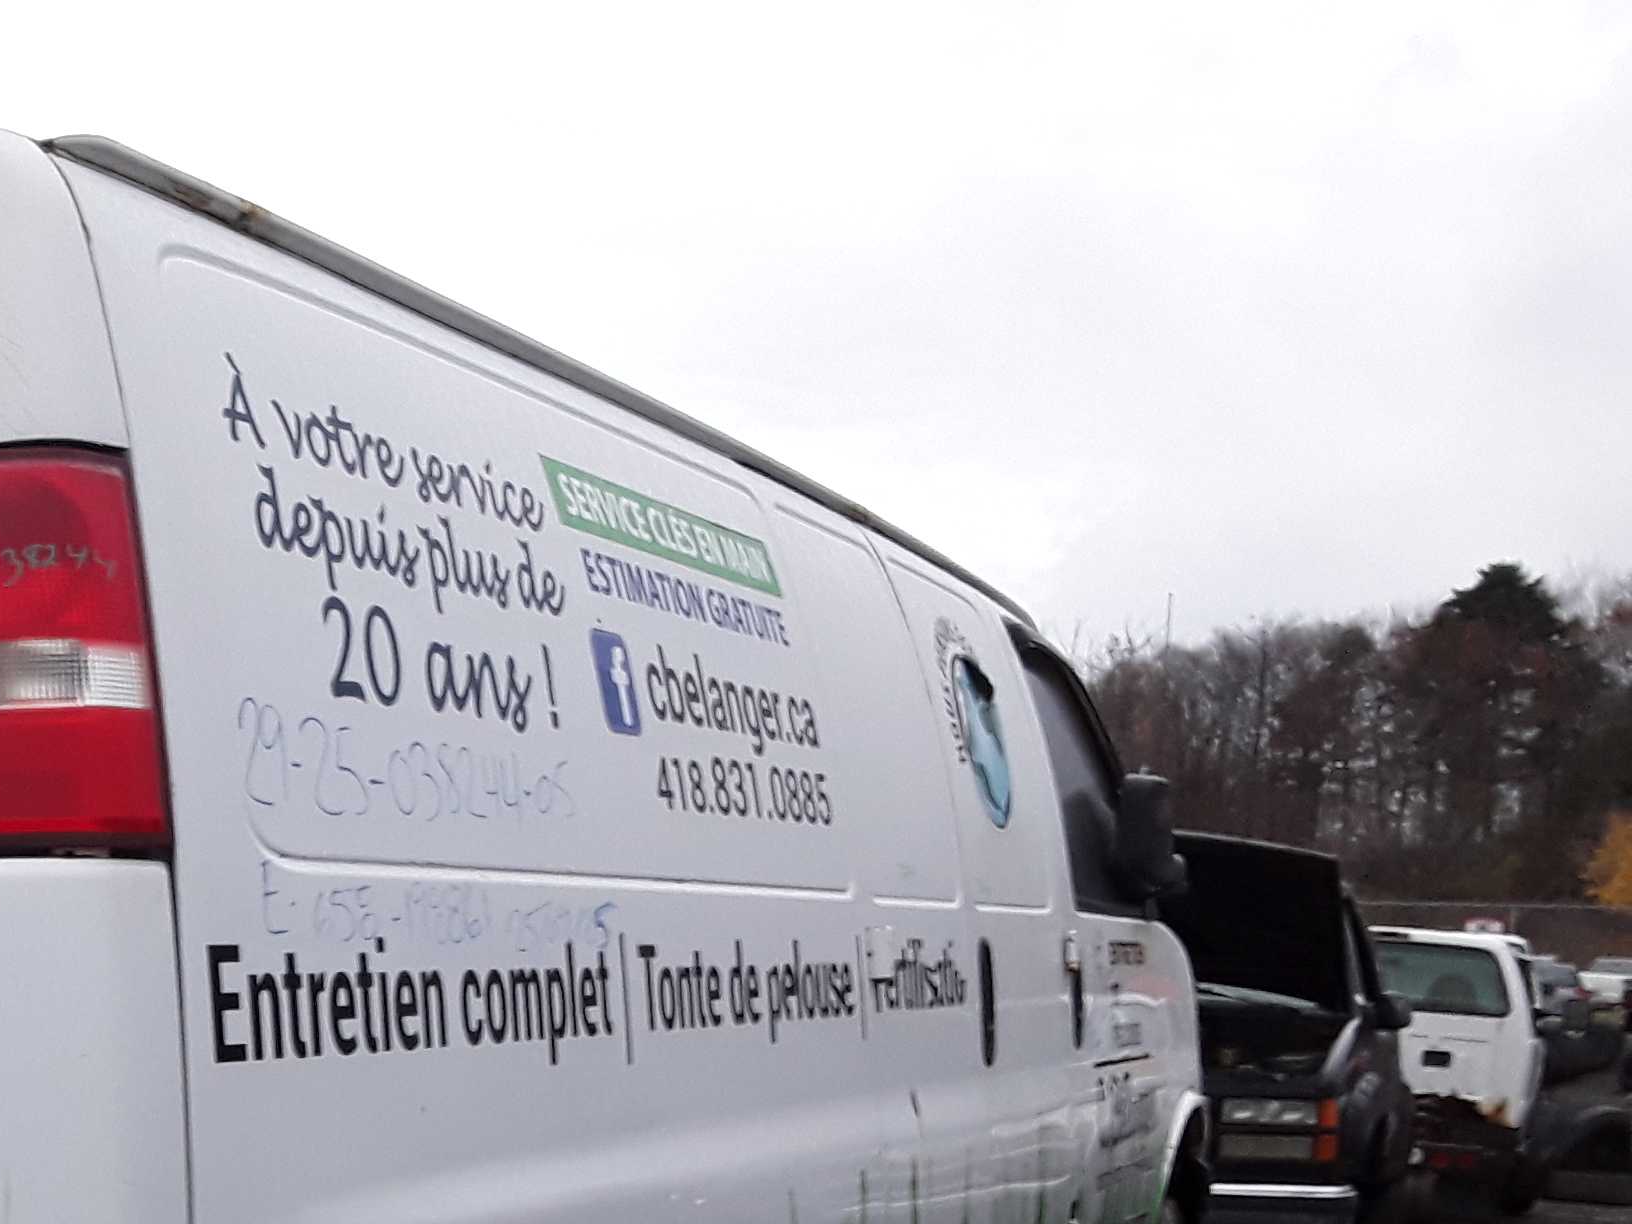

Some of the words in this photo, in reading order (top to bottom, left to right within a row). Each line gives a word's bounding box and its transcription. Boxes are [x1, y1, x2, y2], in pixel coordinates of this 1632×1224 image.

[222, 352, 265, 448] À
[271, 399, 404, 487] votre
[409, 445, 544, 531] service
[255, 463, 420, 591] depuis
[421, 517, 510, 614] plus
[517, 539, 565, 615] de
[557, 472, 653, 543] SERVICE
[322, 596, 402, 707] 20
[581, 547, 707, 624] ESTIMATION
[706, 588, 790, 648] GRATUITE
[647, 643, 820, 755] cbelanger.ca
[657, 755, 832, 826] 418.831.0885
[206, 937, 449, 1064] Entretien
[461, 941, 614, 1065] complet
[637, 943, 722, 1032] Tonte
[728, 938, 762, 1024] de
[766, 938, 856, 1044] pelouse
